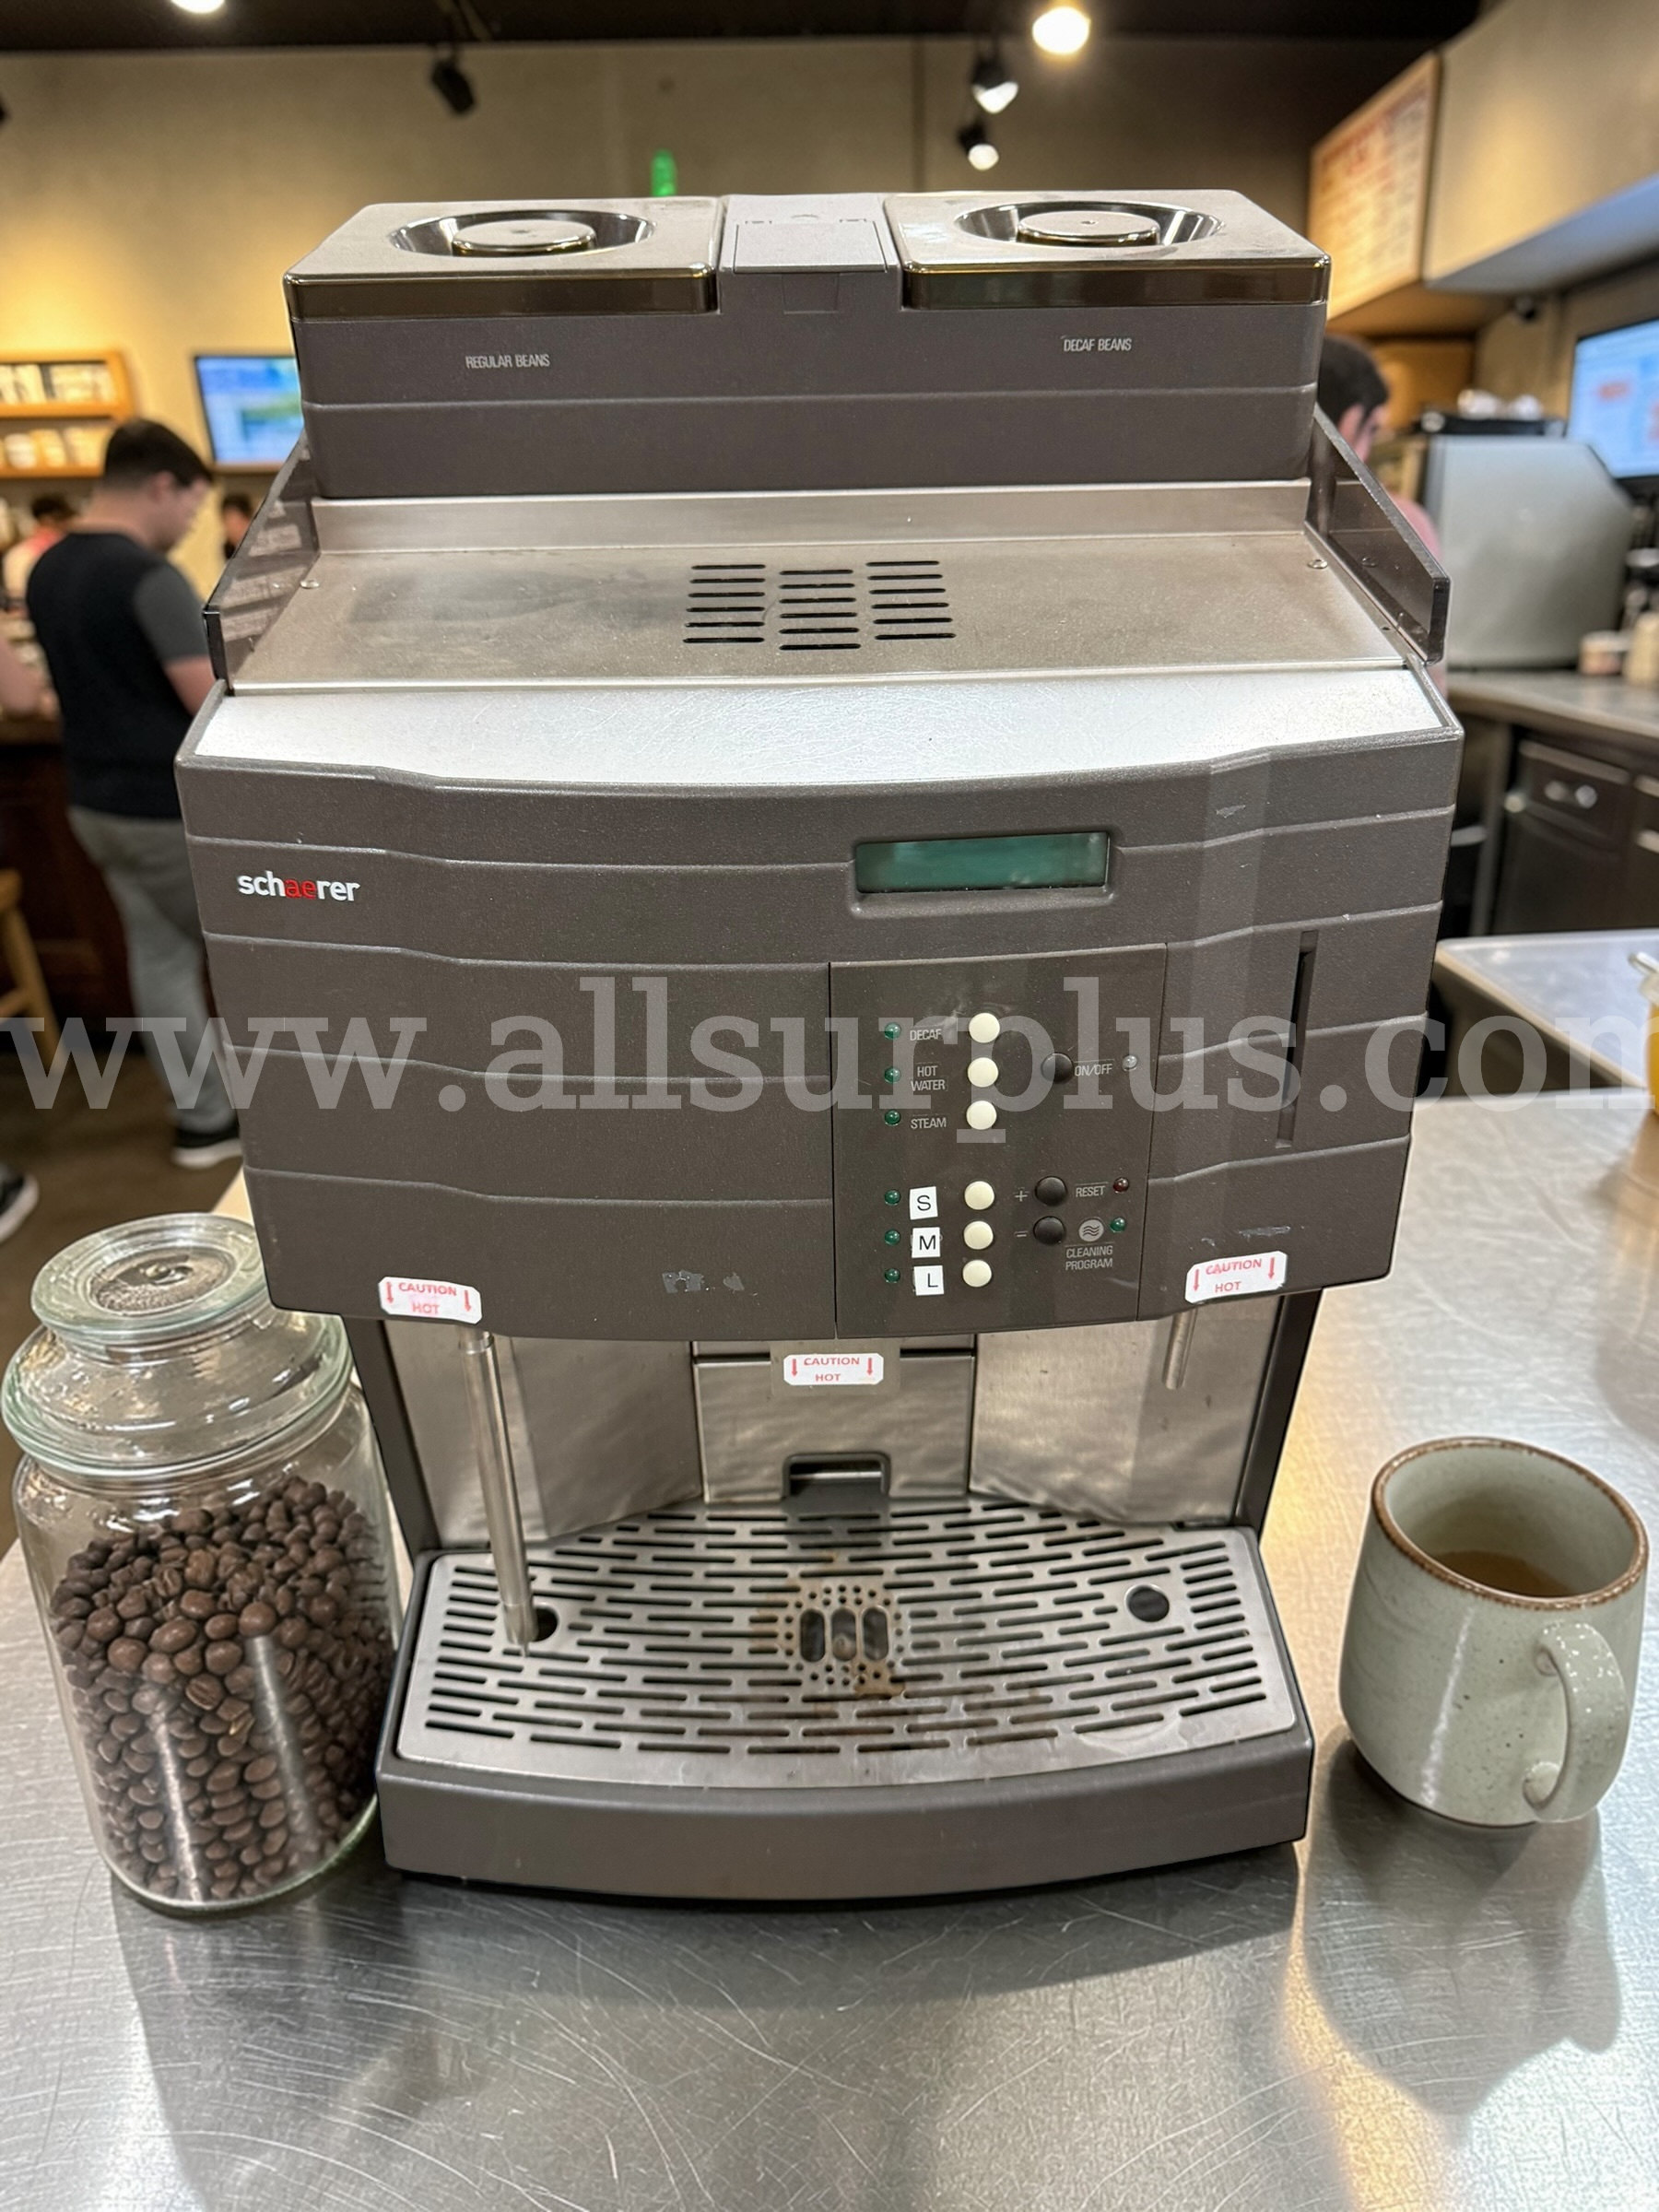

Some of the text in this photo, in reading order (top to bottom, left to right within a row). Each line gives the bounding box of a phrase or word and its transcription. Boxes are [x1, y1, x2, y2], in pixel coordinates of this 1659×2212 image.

[1064, 337, 1132, 351] DECAF BEANS
[465, 354, 550, 369] REGULAR BEANS
[237, 870, 360, 901] schaerer
[910, 1029, 942, 1041] DECAF
[917, 1065, 938, 1077] HOT
[1074, 1063, 1113, 1077] ON/OFF
[911, 1079, 946, 1091] WATER
[911, 1117, 947, 1130] STEAM
[1076, 1185, 1106, 1198] RESET
[917, 1194, 931, 1211] S
[919, 1234, 936, 1251] M
[1065, 1245, 1113, 1259] CLEANING
[1065, 1258, 1113, 1271] PROGRAM
[1206, 1258, 1263, 1276] CAUTION
[927, 1273, 939, 1288] L
[1215, 1281, 1241, 1293] HOT
[398, 1282, 457, 1297] CAUTION
[412, 1302, 440, 1314] HOT
[804, 1357, 860, 1366] CAUTION
[815, 1373, 841, 1382] HOT
